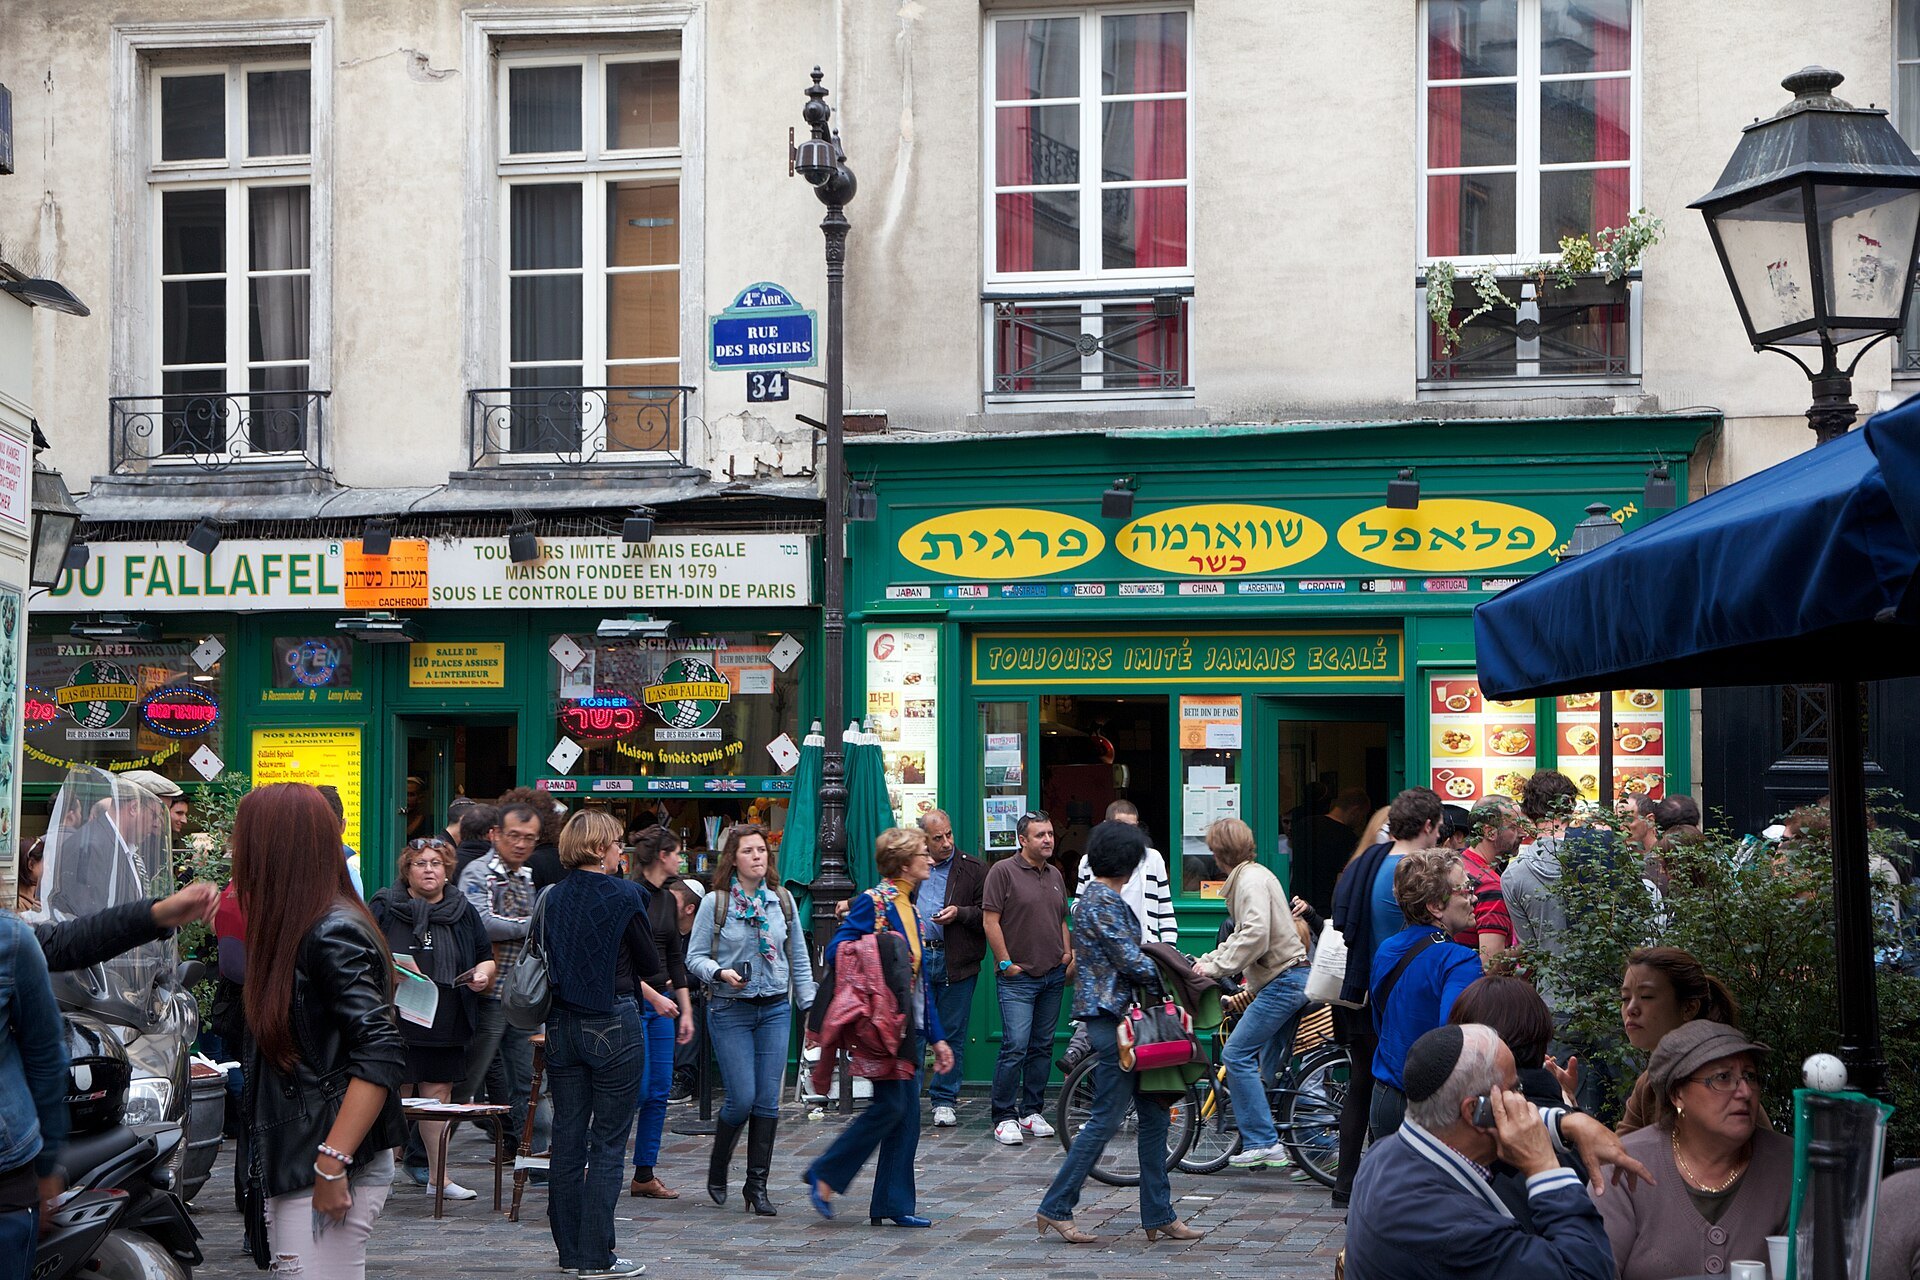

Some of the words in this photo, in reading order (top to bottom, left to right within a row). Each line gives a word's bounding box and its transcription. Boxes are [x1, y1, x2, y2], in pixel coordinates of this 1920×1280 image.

[748, 326, 778, 339] RUE
[716, 344, 743, 357] DES
[748, 341, 811, 355] ROSIERS
[752, 373, 784, 398] 34
[1131, 518, 1304, 553] שווארמה
[1357, 520, 1536, 552] פלאפל
[570, 544, 616, 559] IMITE
[622, 543, 685, 558] JAMAIS
[691, 542, 747, 557] EGALE
[920, 529, 1090, 561] פרגית
[505, 565, 570, 580] MAISON
[576, 564, 644, 579] FONDEE
[650, 563, 672, 578] EN
[678, 563, 717, 578] 1979
[1188, 555, 1247, 573] כשר
[124, 554, 339, 596] FALLAFEL
[345, 570, 383, 587] כשרות
[389, 570, 428, 588] תעודת
[432, 586, 476, 600] SOUS
[483, 586, 502, 600] LE
[508, 585, 597, 600] CONTROLE
[604, 585, 627, 599] DU
[633, 584, 713, 599] BETH-DIN
[720, 583, 741, 598] DE
[747, 583, 796, 598] PARIS
[1071, 585, 1103, 595] MEXICO
[1192, 584, 1218, 594] CHINA
[1247, 583, 1283, 593] ARGENTINA
[1307, 582, 1343, 592] CROATIA
[1431, 580, 1467, 590] PORTUGAL
[896, 588, 922, 598] JAPAN
[379, 597, 429, 607] CACHEROUT
[57, 644, 133, 656] FALLAFEL
[639, 638, 728, 650] SCHAWARMA
[285, 648, 341, 668] OPEN
[436, 648, 464, 656] SALLE
[466, 648, 478, 656] DE
[756, 655, 770, 663] PARI
[988, 647, 1112, 671] TOUJOURS
[1123, 638, 1193, 670] IMITÉ
[1203, 647, 1296, 671] JAMAIS
[1308, 636, 1388, 670] EGALÉ
[413, 656, 429, 667] 110
[431, 659, 462, 667] PLACES
[465, 659, 498, 667] ASSISES
[60, 690, 78, 703] L'AS
[80, 686, 89, 698] du
[91, 685, 135, 699] FALLAFEL
[648, 688, 667, 702] L'AS
[668, 686, 678, 698] du
[680, 684, 727, 699] FALLAFEL
[869, 692, 894, 706] 파리
[568, 708, 635, 729] כשר
[1201, 707, 1211, 716] DIN
[1213, 707, 1221, 716] DE
[1222, 707, 1239, 716] PARIS
[24, 740, 64, 767] oujours
[108, 755, 149, 772] jamais
[151, 740, 180, 765] égalé
[617, 740, 654, 762] Maison
[691, 747, 723, 766] depuis
[725, 740, 744, 757] 1979
[544, 781, 575, 791] CANADA
[606, 781, 621, 790] USA
[658, 781, 685, 790] ISRAEL
[772, 781, 793, 790] BRAZ
